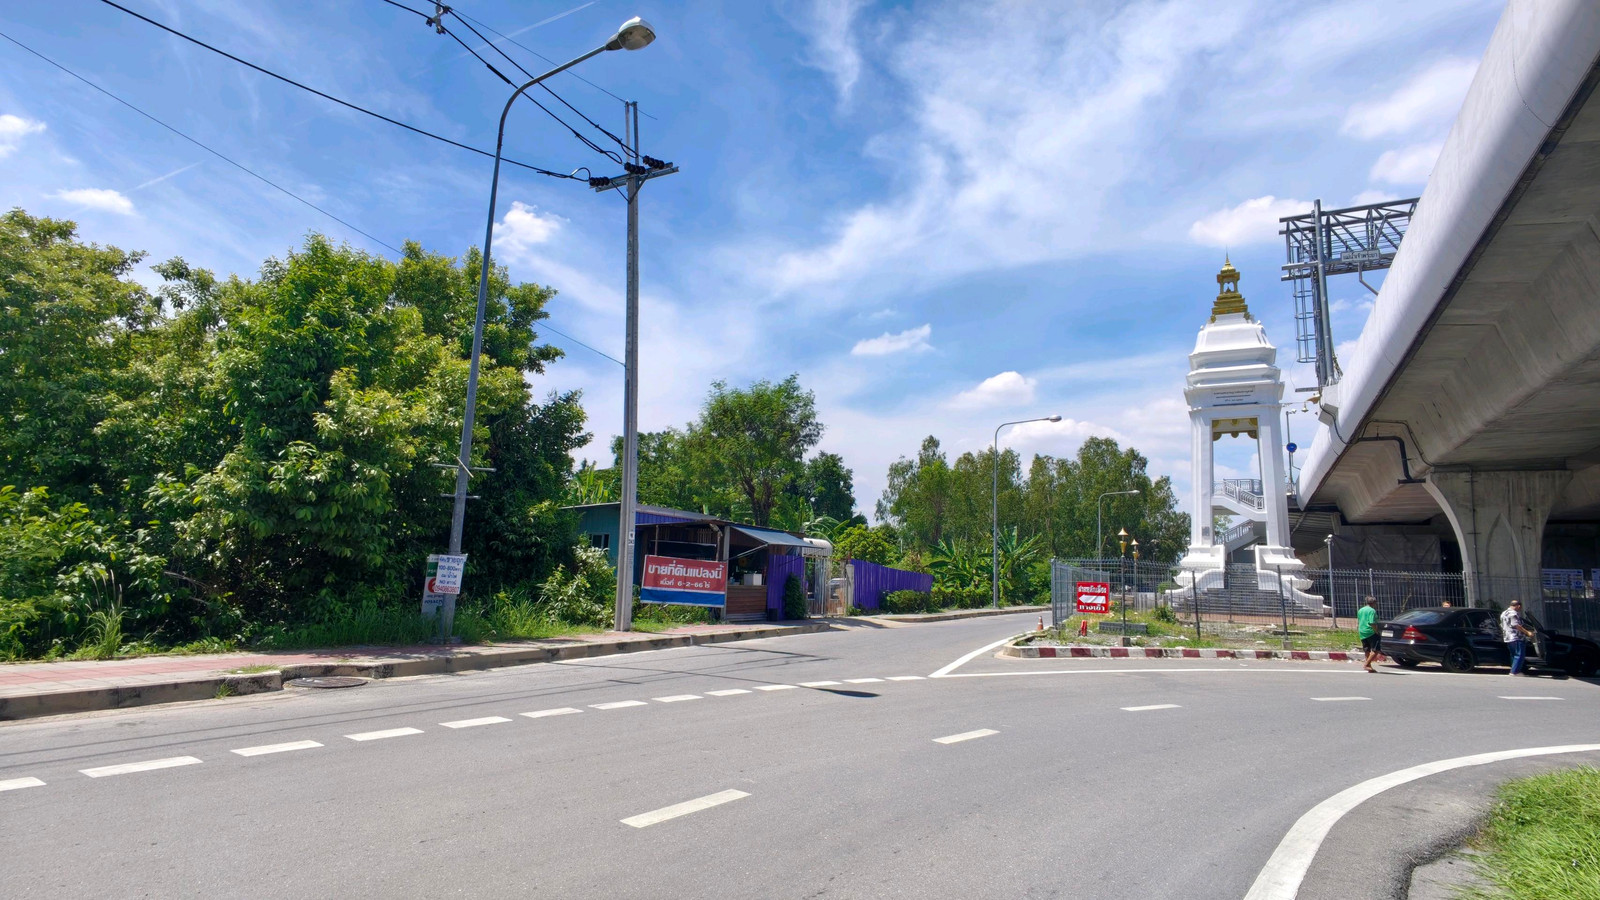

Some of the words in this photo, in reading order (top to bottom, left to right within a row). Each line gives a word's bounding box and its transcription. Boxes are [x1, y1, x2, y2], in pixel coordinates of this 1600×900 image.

[648, 561, 724, 578] ขายที่ดินแปลงนี้
[660, 577, 674, 586] เนื้อที่
[677, 580, 703, 588] 6-2-66
[1079, 603, 1105, 611] ทางเข้า
